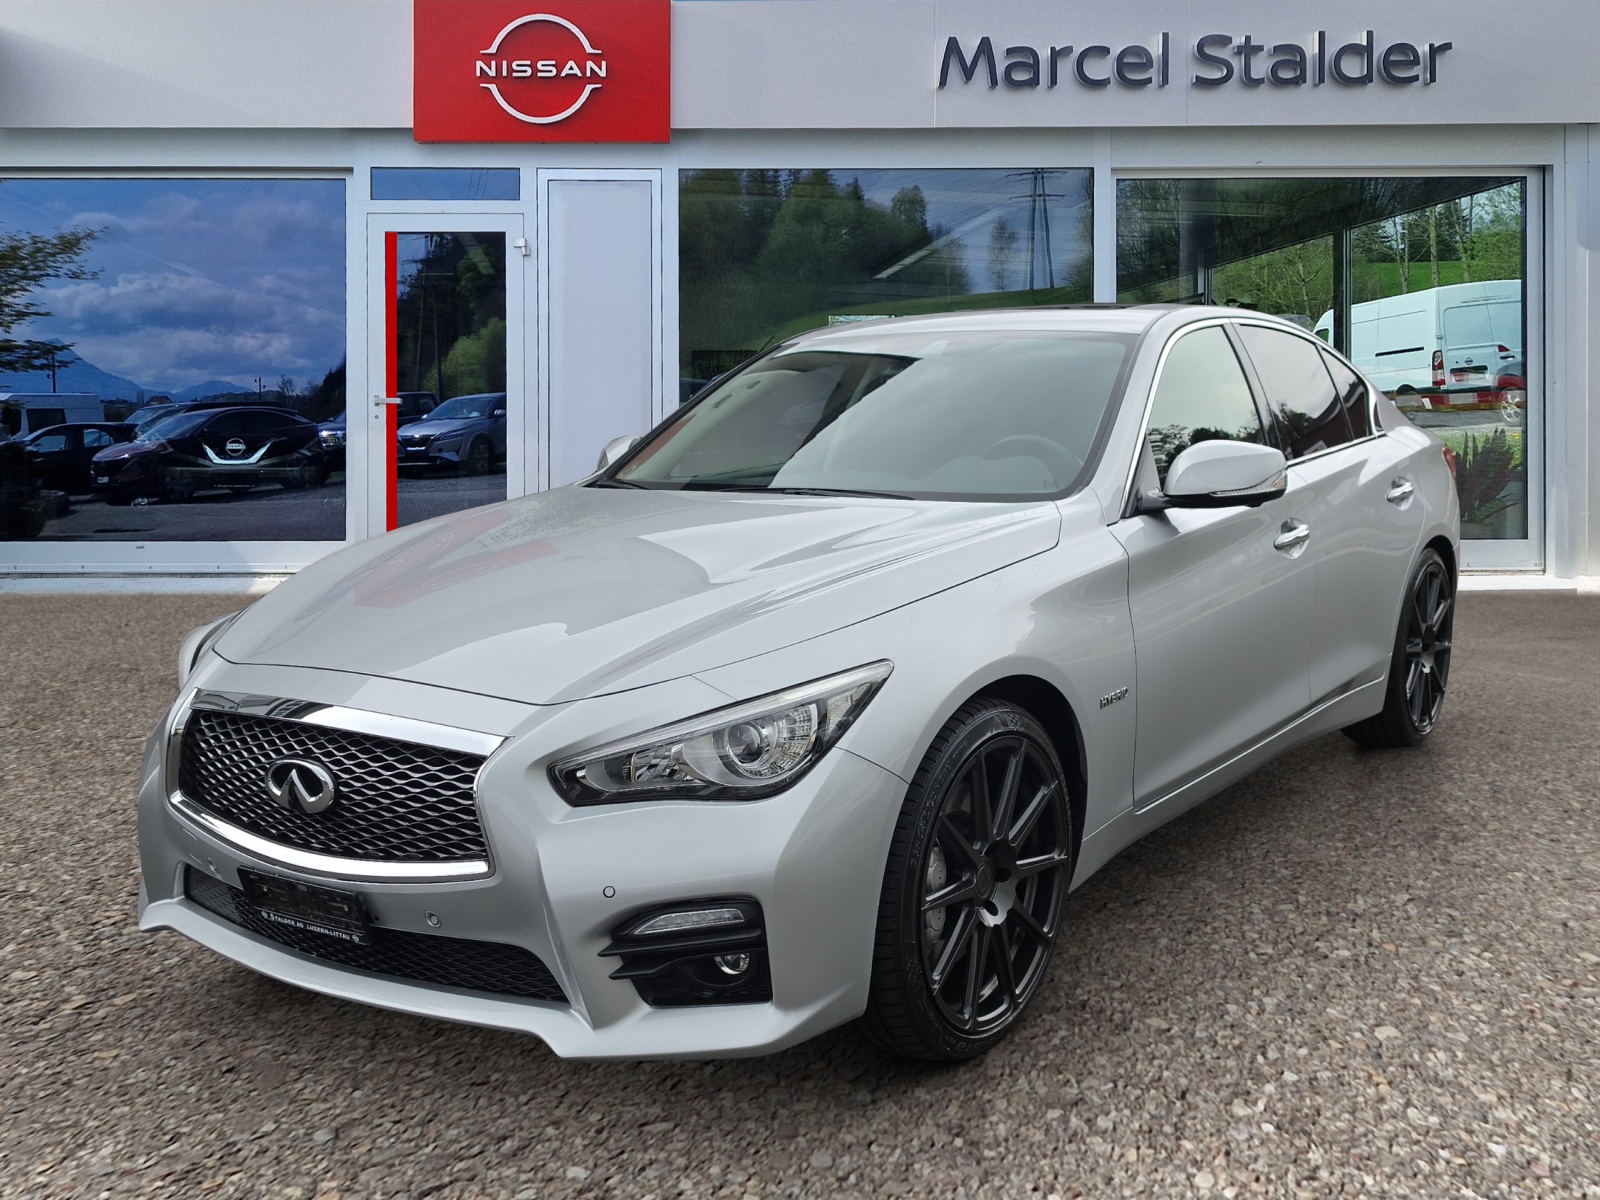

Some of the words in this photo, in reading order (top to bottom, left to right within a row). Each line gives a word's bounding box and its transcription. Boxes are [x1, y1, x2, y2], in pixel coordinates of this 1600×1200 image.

[475, 60, 607, 78] NISSAN
[938, 31, 1170, 89] Marcel
[1191, 30, 1453, 87] Stalder
[1099, 686, 1129, 710] HYBRID
